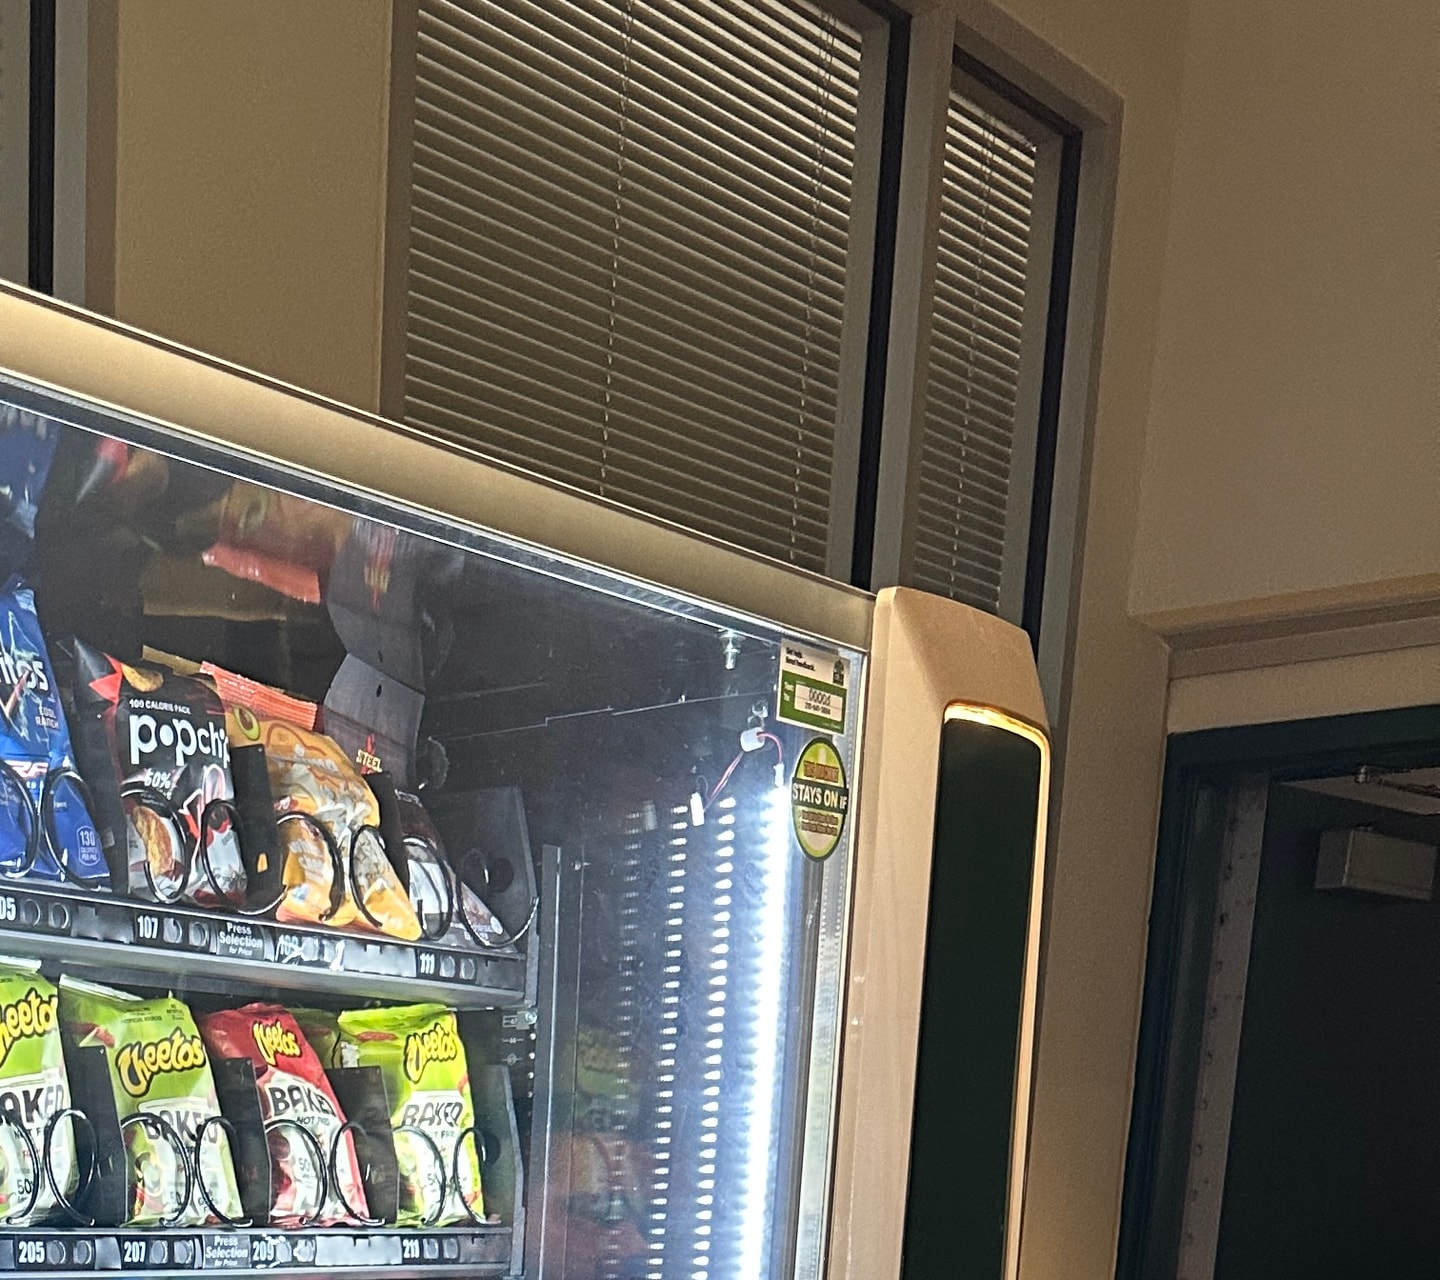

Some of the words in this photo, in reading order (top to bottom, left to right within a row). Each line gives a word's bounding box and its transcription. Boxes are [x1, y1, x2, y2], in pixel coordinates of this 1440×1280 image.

[356, 749, 383, 773] STEEL
[792, 782, 822, 806] STAYS
[823, 788, 839, 809] ON
[839, 795, 848, 810] IF
[79, 830, 96, 847] 130
[137, 914, 159, 939] 107
[226, 921, 253, 936] Press
[219, 932, 262, 950] Selection
[419, 952, 436, 974] 111
[251, 1018, 304, 1068] Cheetos
[403, 1022, 459, 1085] Cheetos
[115, 1027, 207, 1098] Cheetos
[267, 1083, 337, 1119] BAKED
[402, 1101, 464, 1128] BAKED
[13, 1129, 33, 1139] NT
[18, 1240, 46, 1264] 205
[123, 1240, 146, 1263] 207
[205, 1245, 249, 1260] Selection
[214, 1235, 239, 1247] Press
[252, 1239, 275, 1262] 209
[402, 1238, 421, 1259] 211
